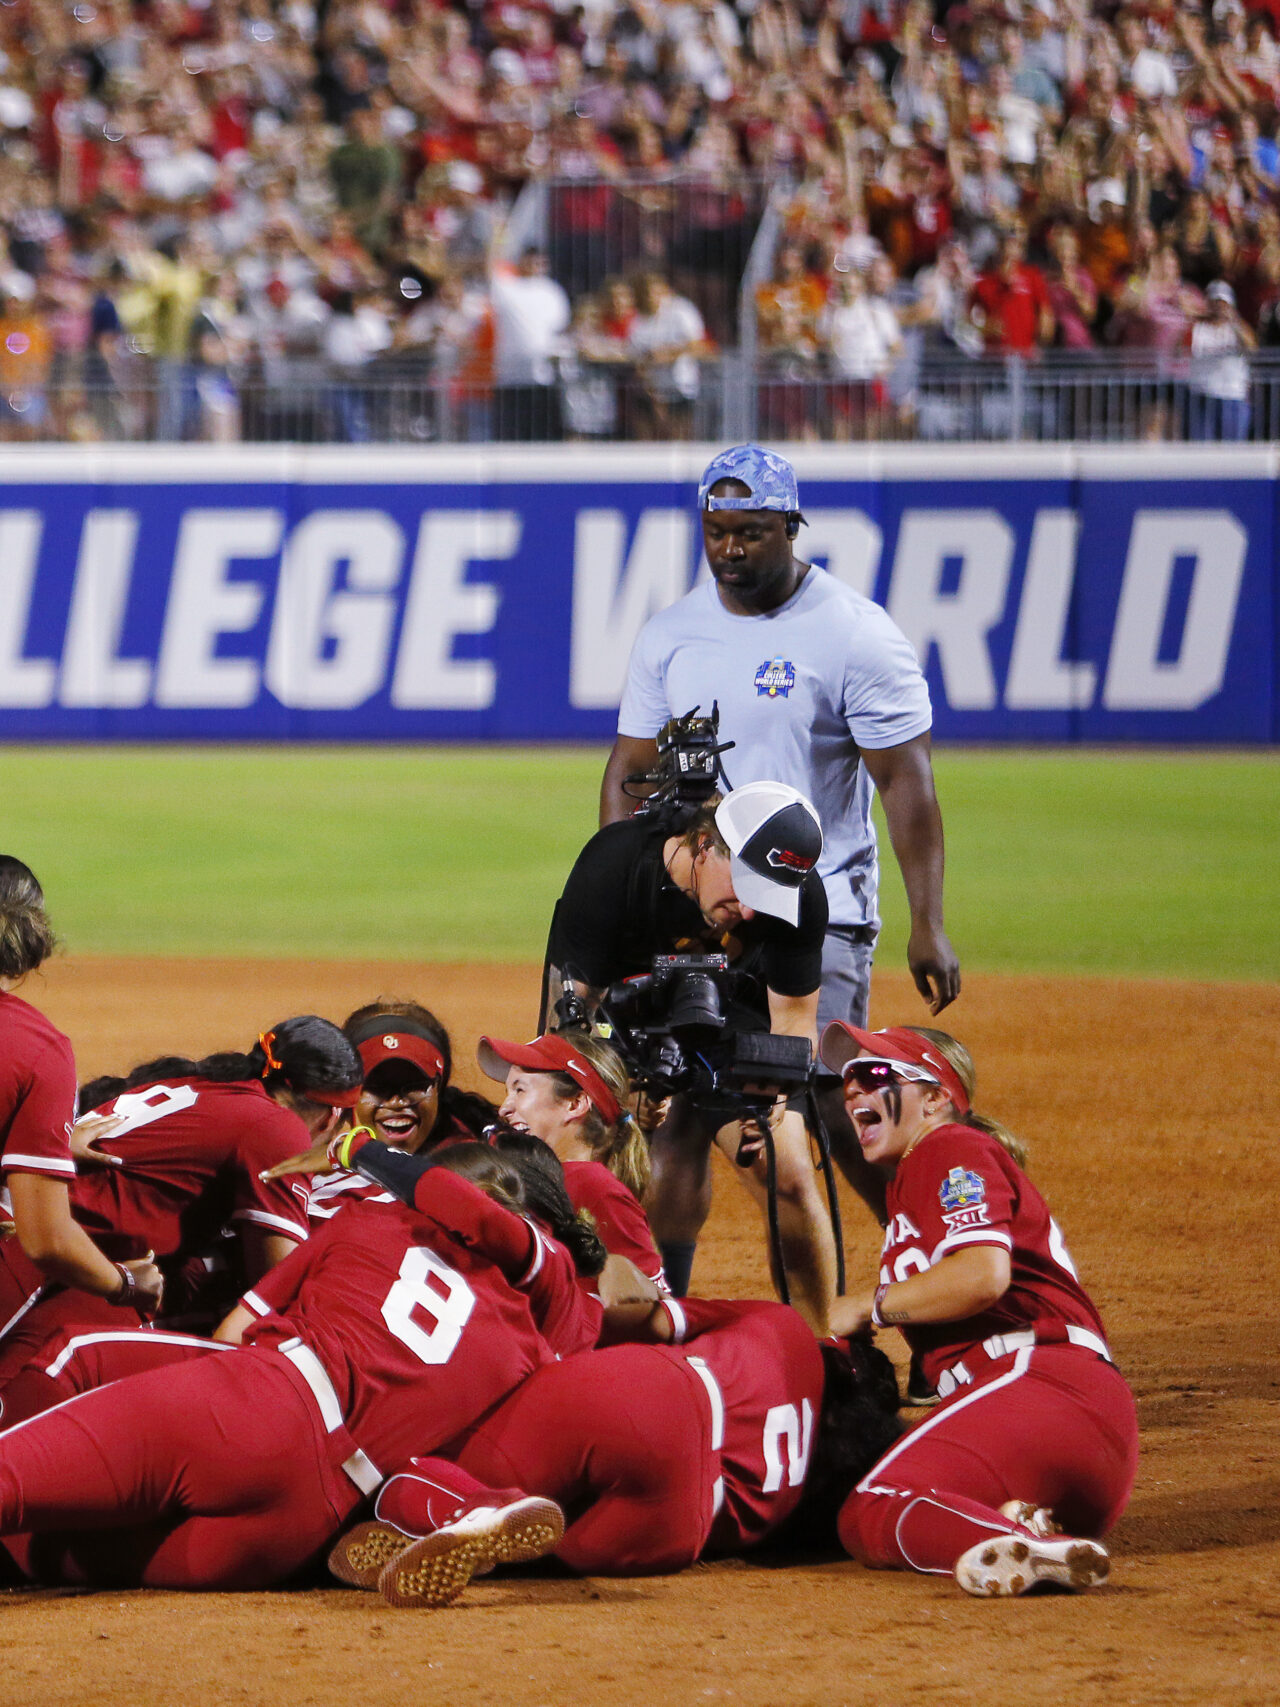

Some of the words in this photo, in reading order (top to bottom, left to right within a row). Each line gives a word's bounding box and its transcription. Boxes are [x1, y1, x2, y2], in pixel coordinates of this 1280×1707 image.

[570, 508, 1247, 711] WRLD
[382, 1035, 400, 1050] OU
[380, 1245, 477, 1366] 8
[761, 1397, 814, 1492] 2
